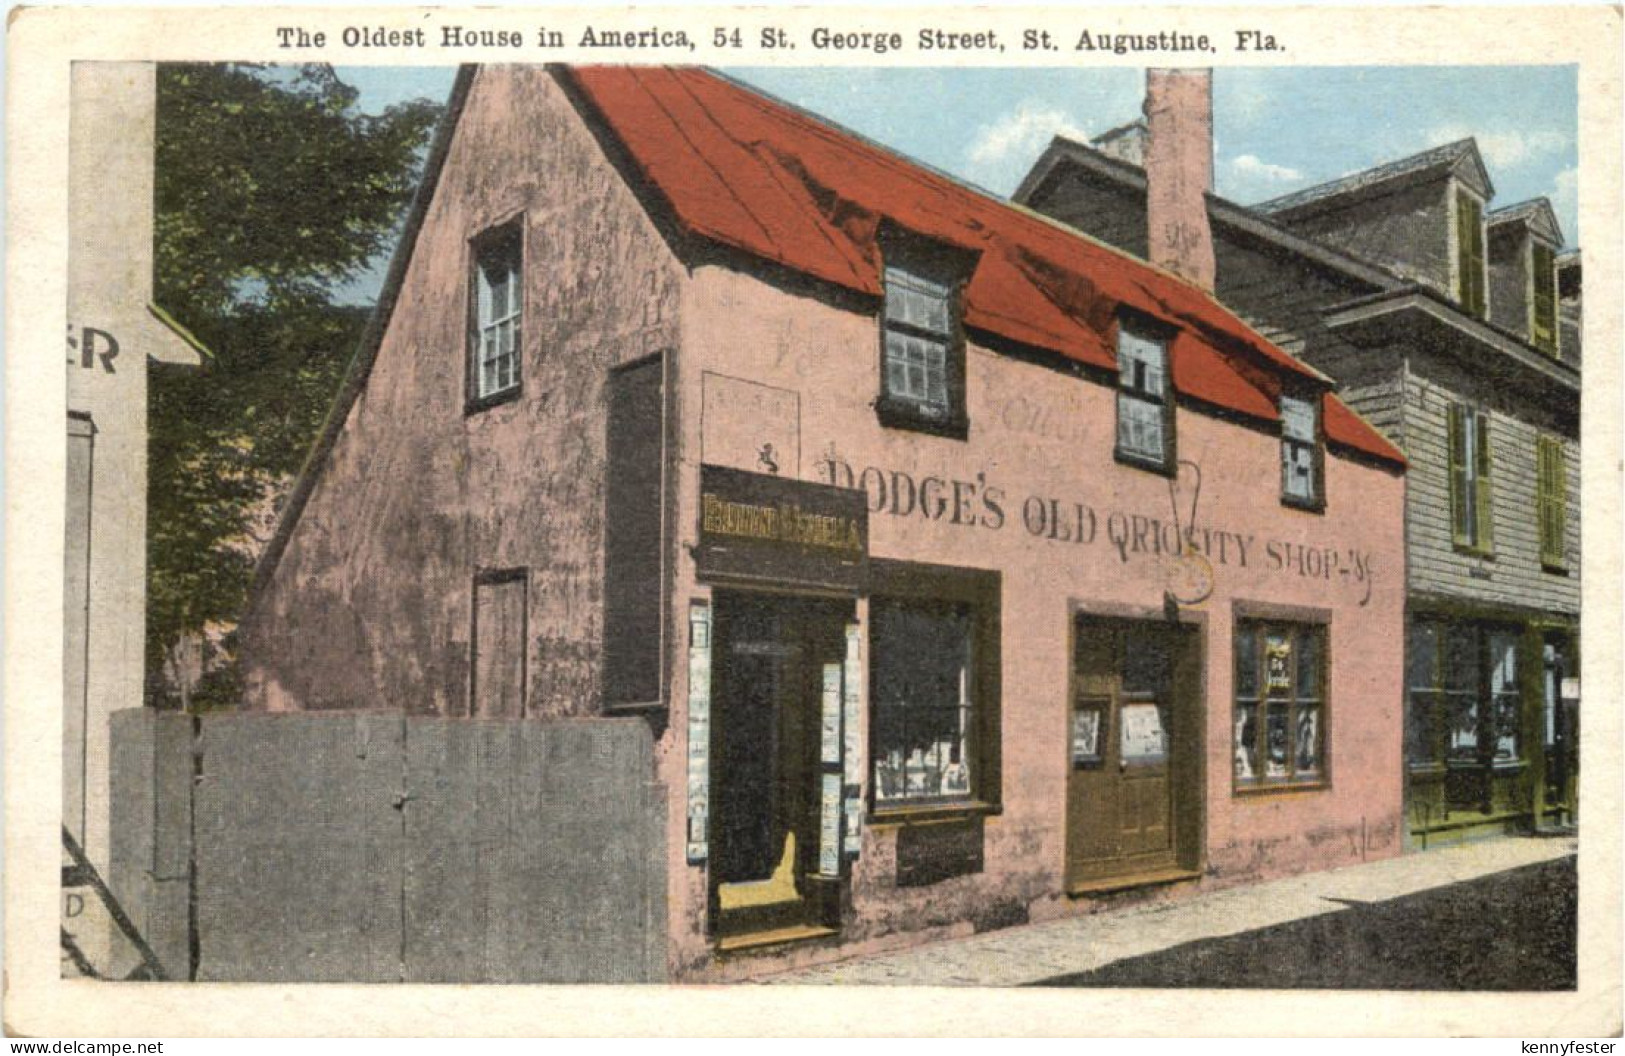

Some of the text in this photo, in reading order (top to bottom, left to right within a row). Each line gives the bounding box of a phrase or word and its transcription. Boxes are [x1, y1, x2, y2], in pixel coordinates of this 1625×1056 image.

[276, 26, 1286, 54] The Oldest House in America, 54 St. George Street, St. Augustine, Fla.
[1023, 495, 1096, 544] OLD
